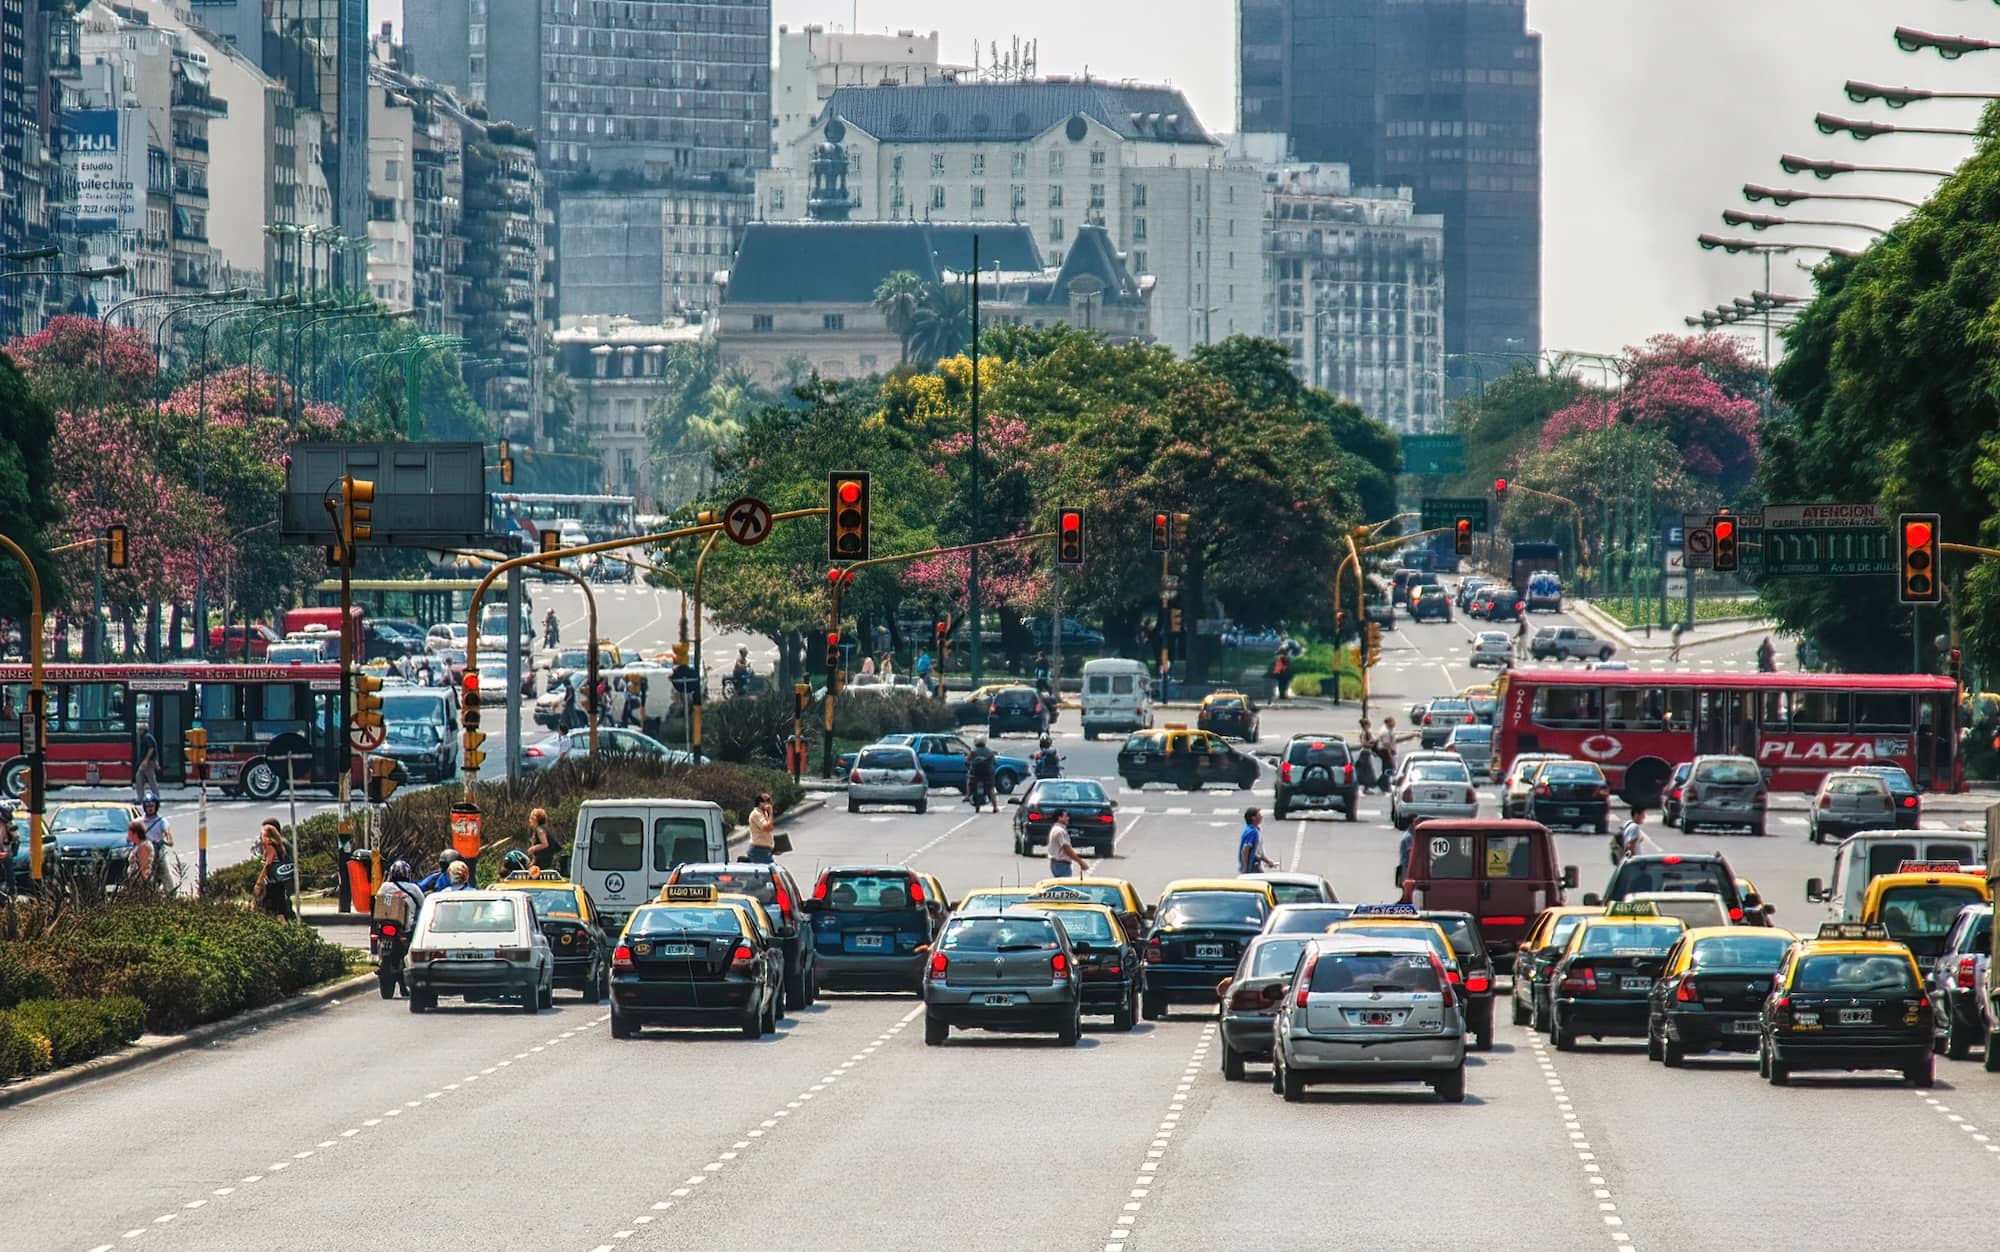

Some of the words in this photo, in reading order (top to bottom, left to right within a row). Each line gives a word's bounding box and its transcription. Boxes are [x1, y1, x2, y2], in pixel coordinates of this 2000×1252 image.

[1803, 506, 1874, 518] ATENCION
[45, 669, 107, 679] CENTRAL
[234, 669, 288, 679] LINIERS
[1760, 741, 1875, 760] PLAZA
[1432, 841, 1448, 854] 110
[669, 887, 688, 897] RADIO
[689, 887, 704, 897] TAXI
